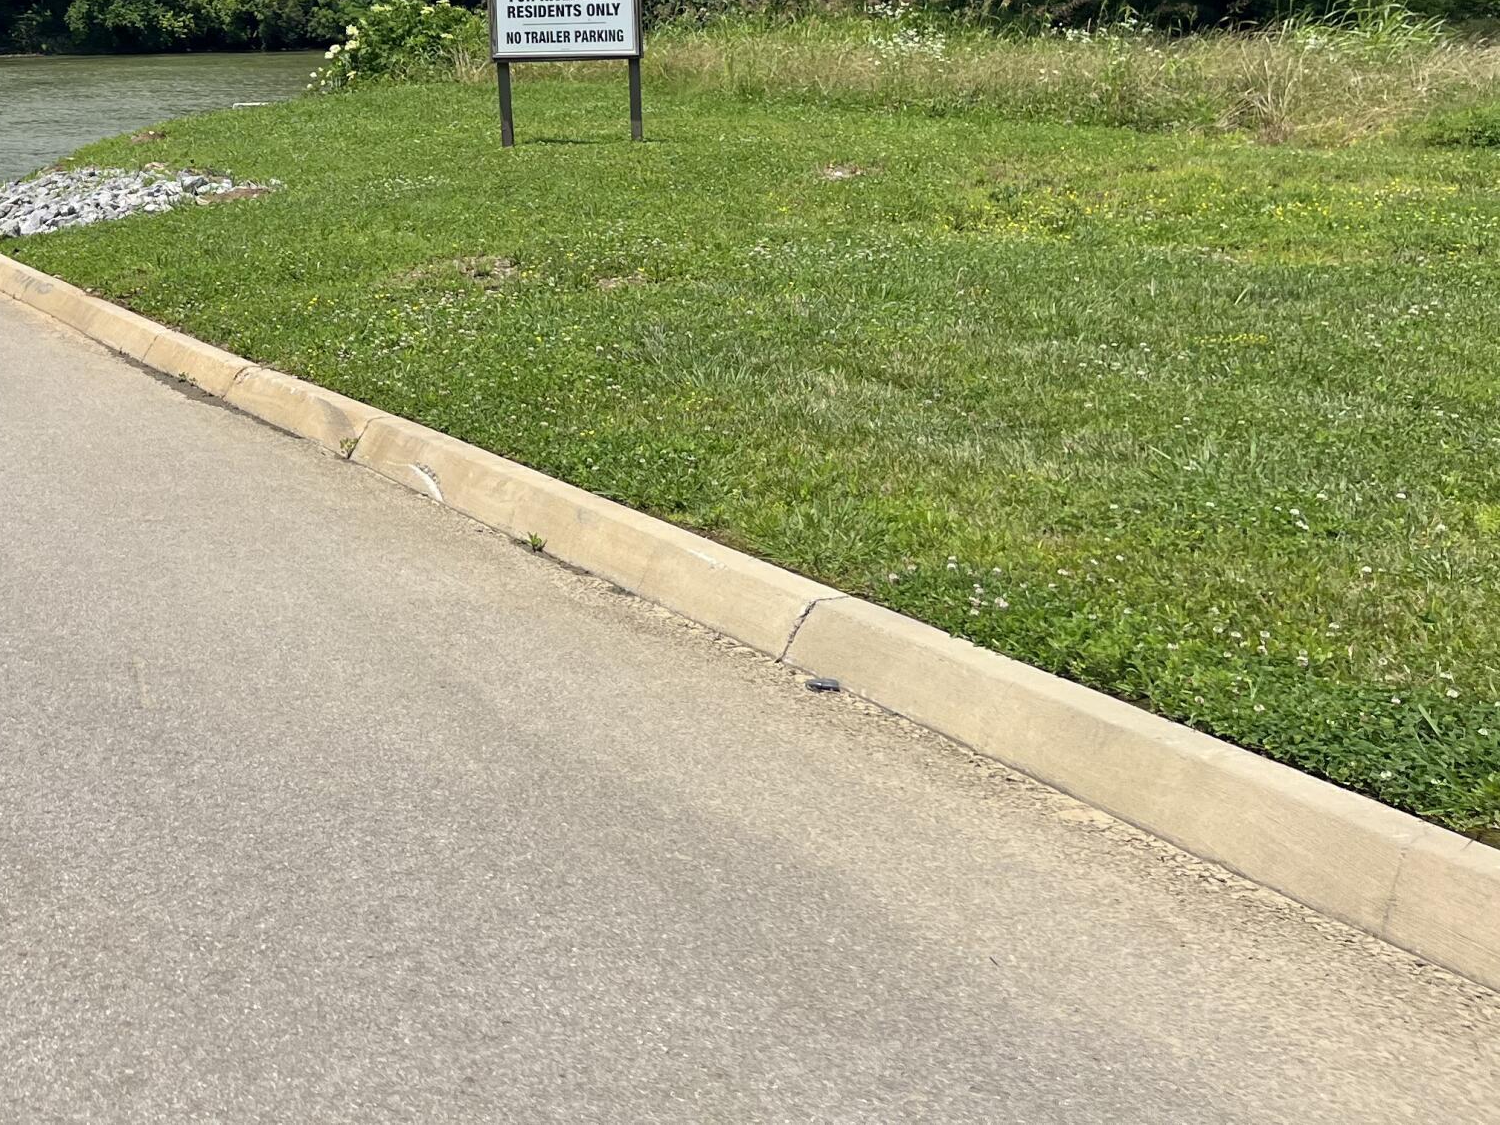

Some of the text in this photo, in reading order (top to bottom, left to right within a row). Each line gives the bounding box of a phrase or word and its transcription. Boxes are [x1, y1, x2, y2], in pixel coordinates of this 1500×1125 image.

[507, 2, 621, 18] RESIDENTS ONLY
[506, 29, 624, 44] NO TRAILER PARKING
